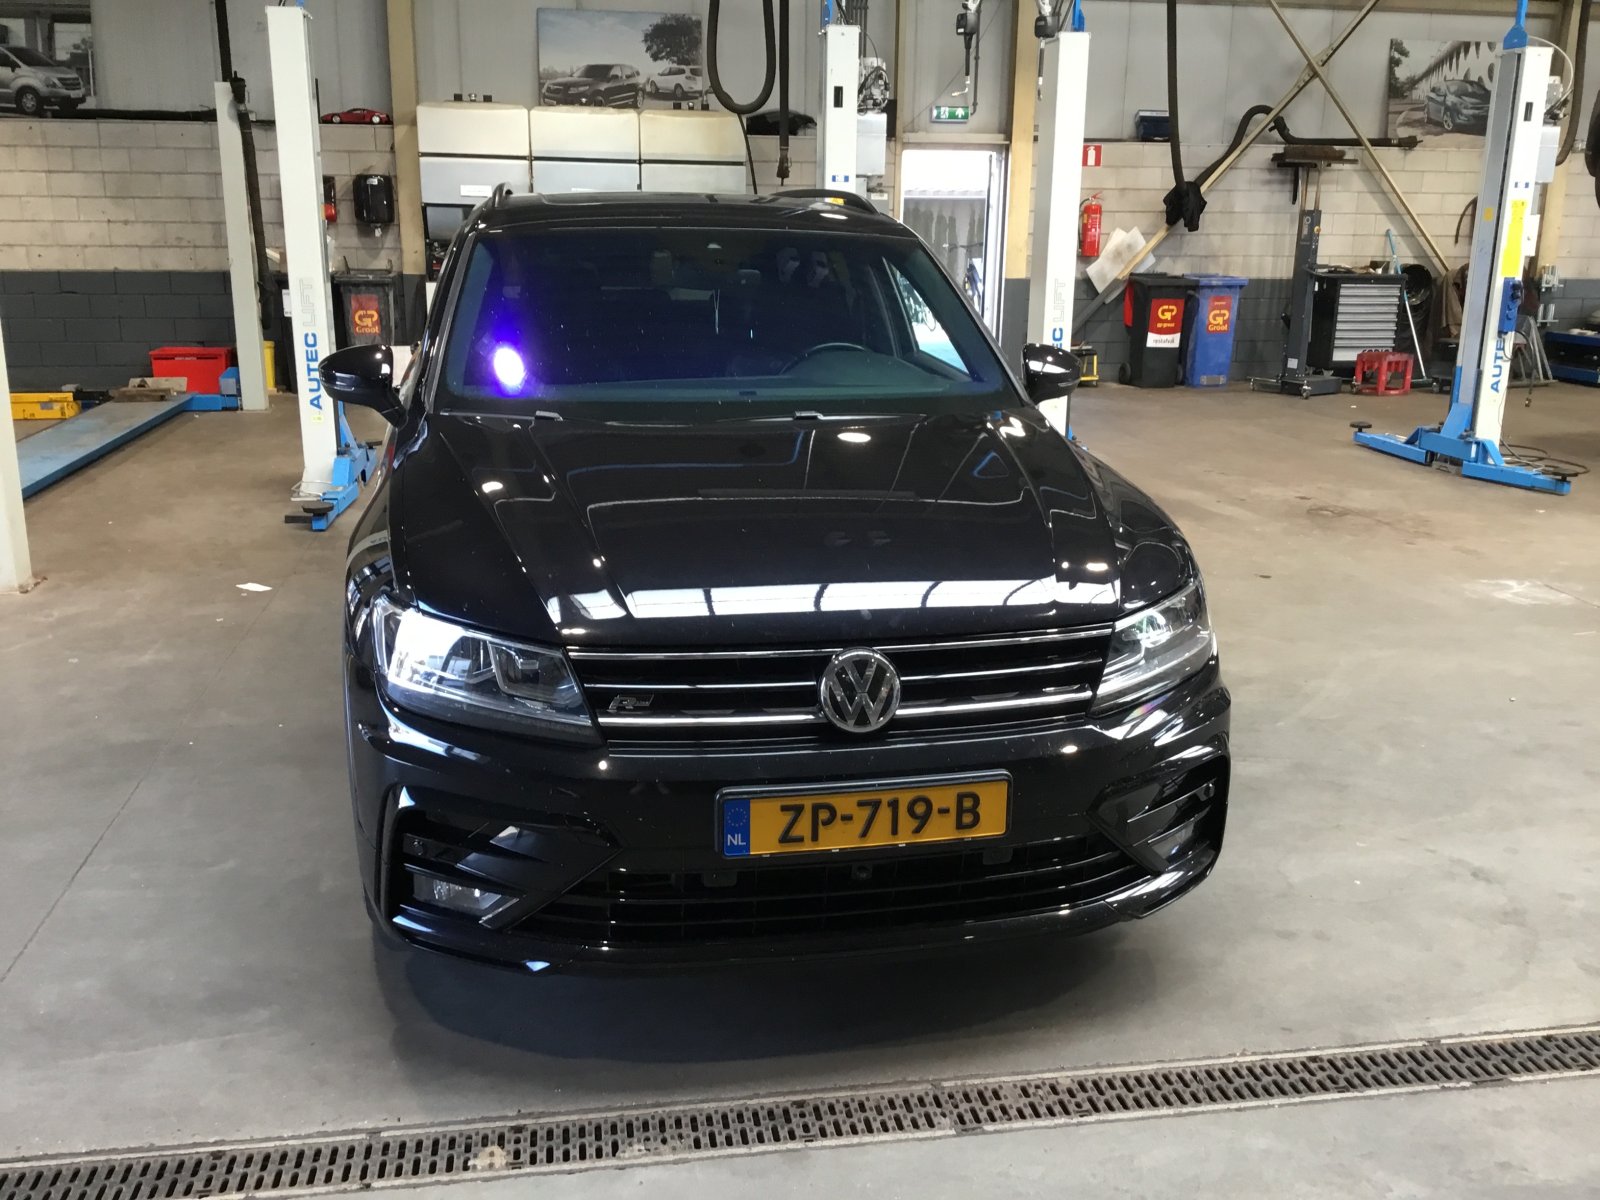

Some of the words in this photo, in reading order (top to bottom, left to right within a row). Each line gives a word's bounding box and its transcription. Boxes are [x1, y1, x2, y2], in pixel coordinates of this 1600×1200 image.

[299, 279, 316, 326] LIFT
[1052, 278, 1066, 322] LIFT
[1208, 323, 1228, 331] Groot
[304, 332, 322, 410] AUTEC
[727, 833, 747, 846] NL
[778, 791, 981, 844] ZP-719-B
